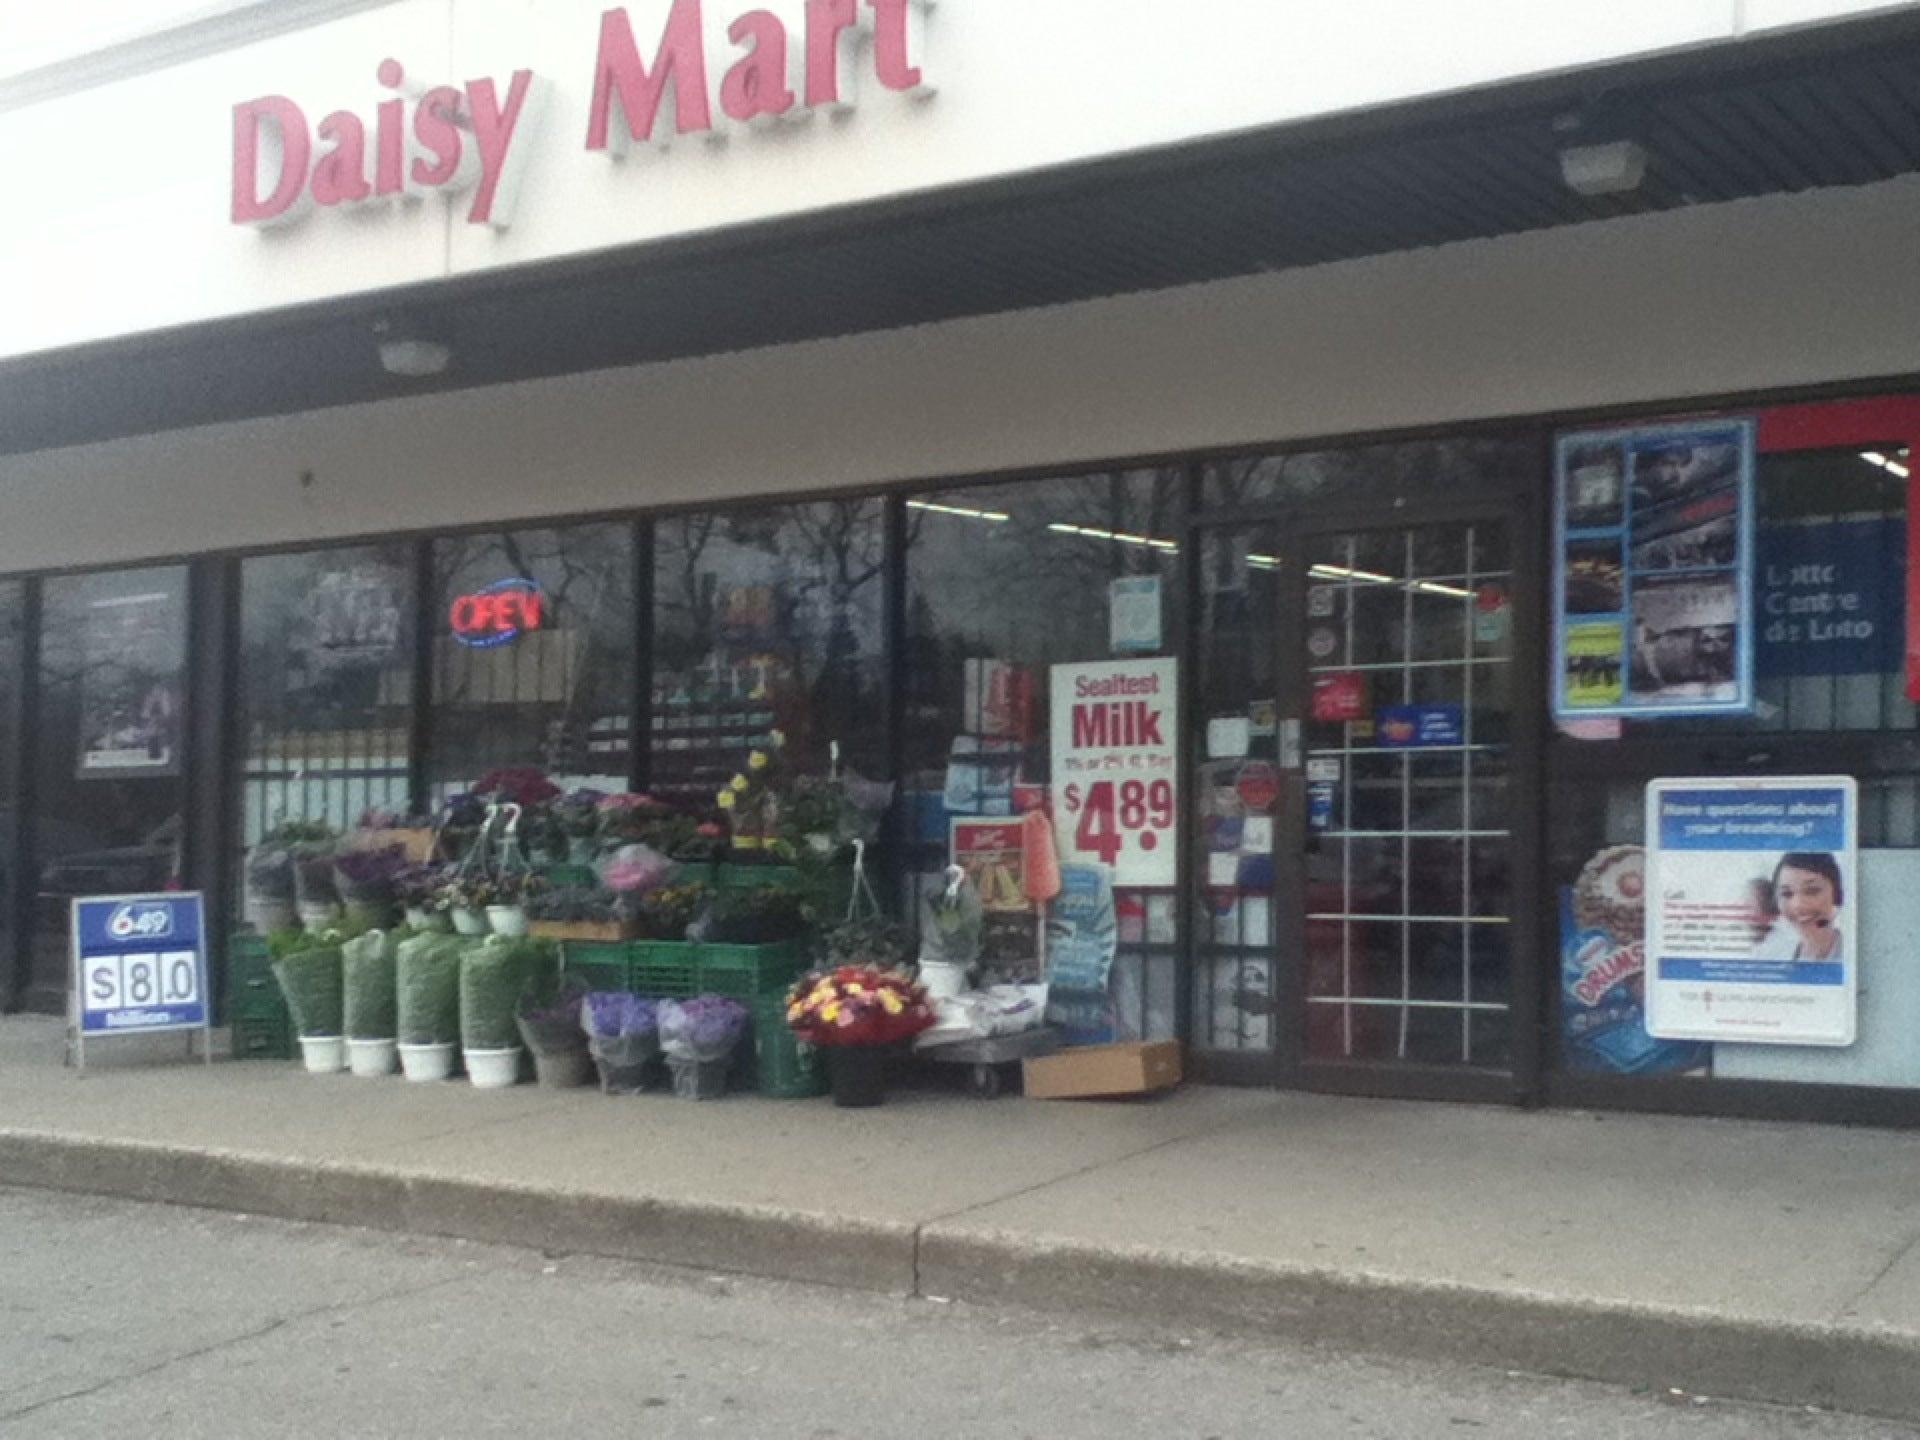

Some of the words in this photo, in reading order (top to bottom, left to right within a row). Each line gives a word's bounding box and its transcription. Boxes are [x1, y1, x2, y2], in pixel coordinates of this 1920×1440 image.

[231, 58, 533, 224] Daisy
[585, 0, 922, 150] Mart
[450, 590, 544, 631] OPEN
[1075, 671, 1159, 698] Sealtest
[1072, 700, 1165, 748] Milk
